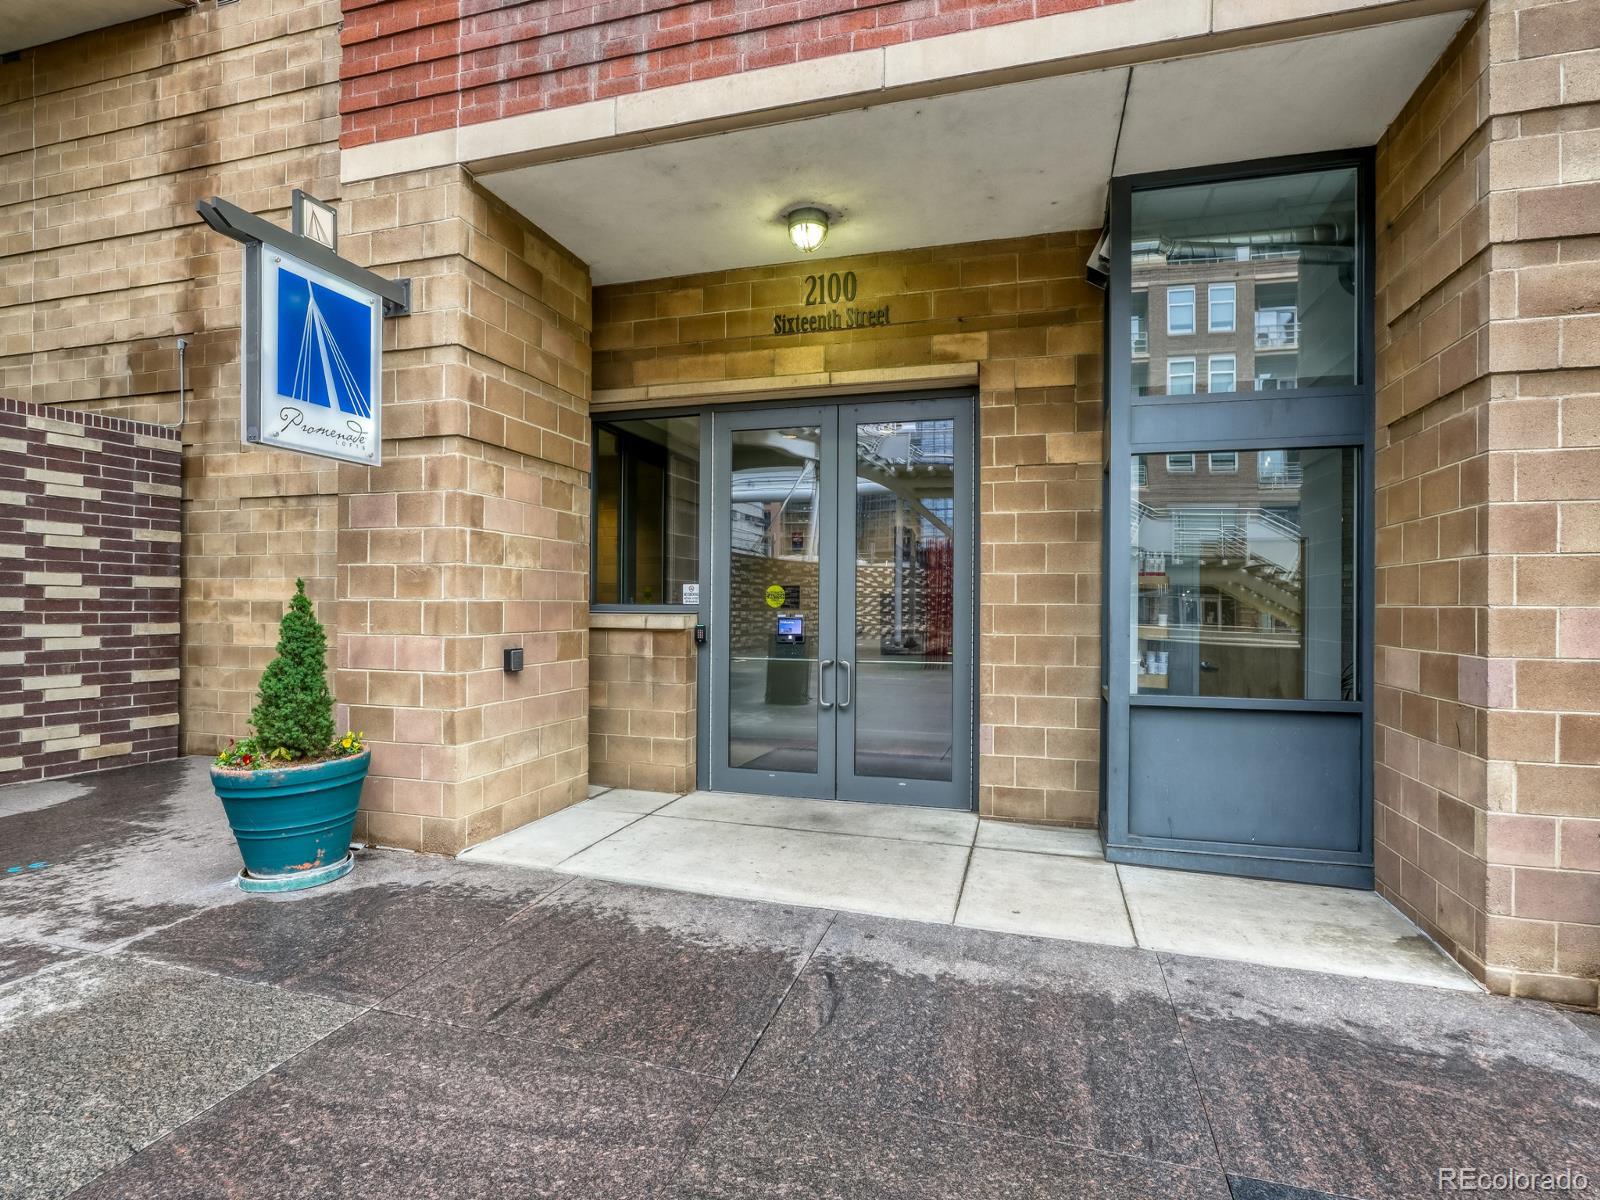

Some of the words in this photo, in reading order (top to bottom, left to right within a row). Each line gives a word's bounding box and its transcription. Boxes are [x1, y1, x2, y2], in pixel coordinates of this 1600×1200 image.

[804, 271, 857, 306] 2100
[774, 308, 842, 335] Sixteenth
[845, 304, 891, 328] Street
[280, 407, 367, 444] Promenade
